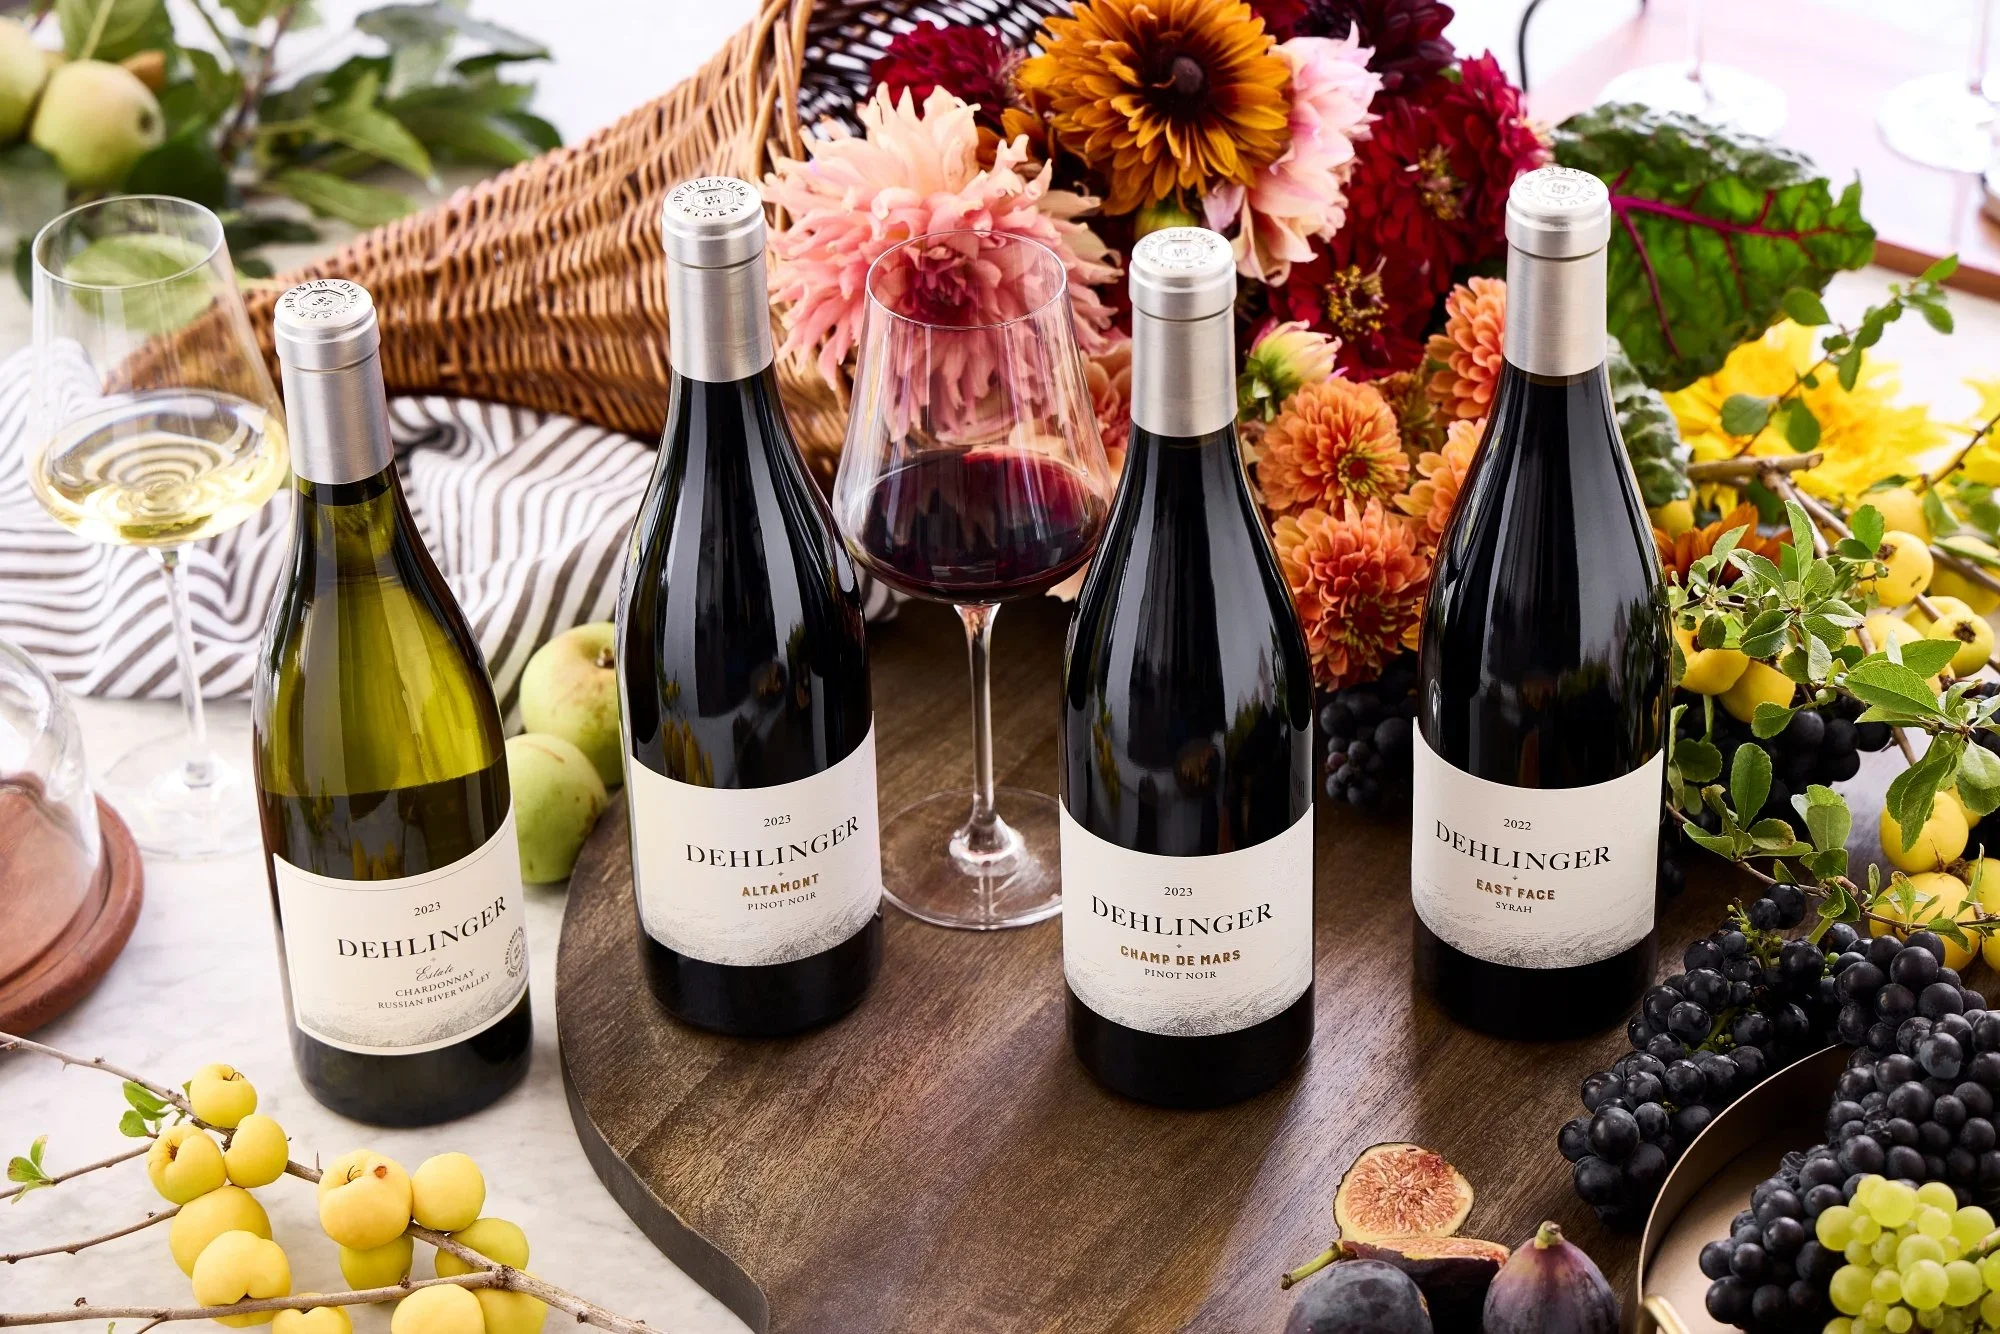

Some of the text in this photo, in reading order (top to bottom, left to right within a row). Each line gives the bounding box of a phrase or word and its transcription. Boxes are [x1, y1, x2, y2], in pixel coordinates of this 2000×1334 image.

[763, 814, 791, 828] 2023
[1503, 818, 1532, 831] 2022
[686, 816, 859, 868] DEHLINGER
[1435, 819, 1611, 871] DEHLINGER
[742, 873, 819, 897] ALTAMONT
[1164, 886, 1193, 897] 2023
[1476, 878, 1556, 900] EAST FACE
[414, 901, 441, 916] 2023
[747, 891, 817, 911] PINOT NOIR
[1495, 901, 1533, 914] SYRAH
[1092, 894, 1273, 936] DEHLINGER
[337, 896, 507, 959] DEHLINGER
[1120, 945, 1241, 966] CHAMP DE MARS
[395, 969, 475, 997] CHARDONNAY
[416, 964, 455, 982] Estate
[1144, 968, 1217, 980] PINOT NOIR
[378, 997, 424, 1009] RUSSIAN
[427, 989, 457, 1004] RIVER
[459, 972, 491, 993] VALLEY
